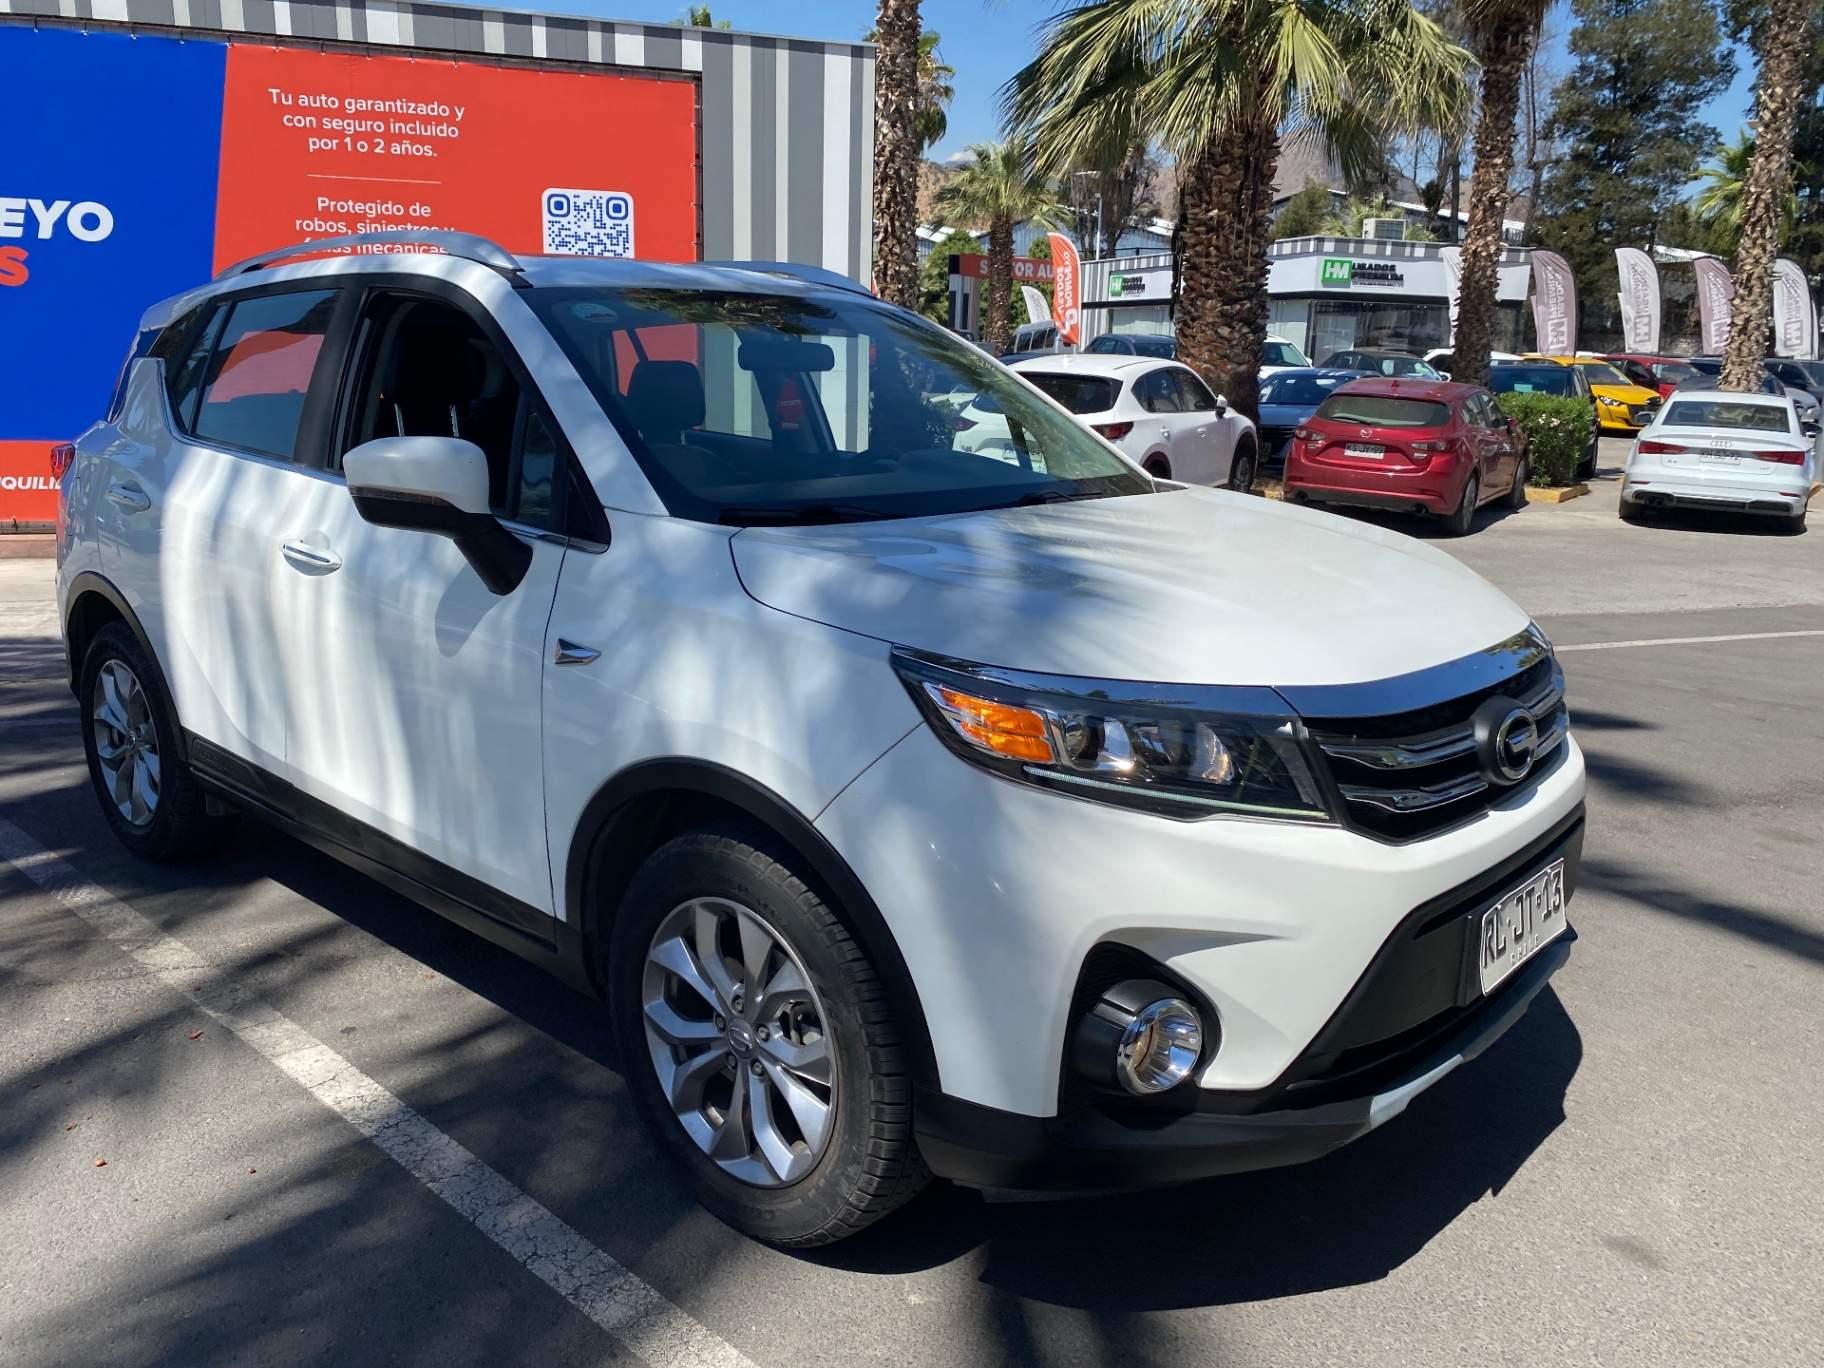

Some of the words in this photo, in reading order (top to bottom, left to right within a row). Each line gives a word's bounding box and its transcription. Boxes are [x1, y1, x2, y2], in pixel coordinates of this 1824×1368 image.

[268, 88, 293, 104] Tu
[298, 94, 339, 109] auto
[344, 97, 450, 117] garantizado
[454, 105, 465, 121] y
[283, 114, 316, 128] con
[322, 117, 385, 134] seguro
[390, 119, 459, 137] incluido
[308, 137, 339, 153] por
[344, 137, 352, 151] 1
[356, 141, 368, 153] o
[373, 138, 385, 153] 2
[390, 140, 438, 157] años.
[317, 196, 404, 218] Protegido
[409, 202, 432, 217] de
[295, 217, 352, 235] robos,
[1324, 261, 1350, 279] HM
